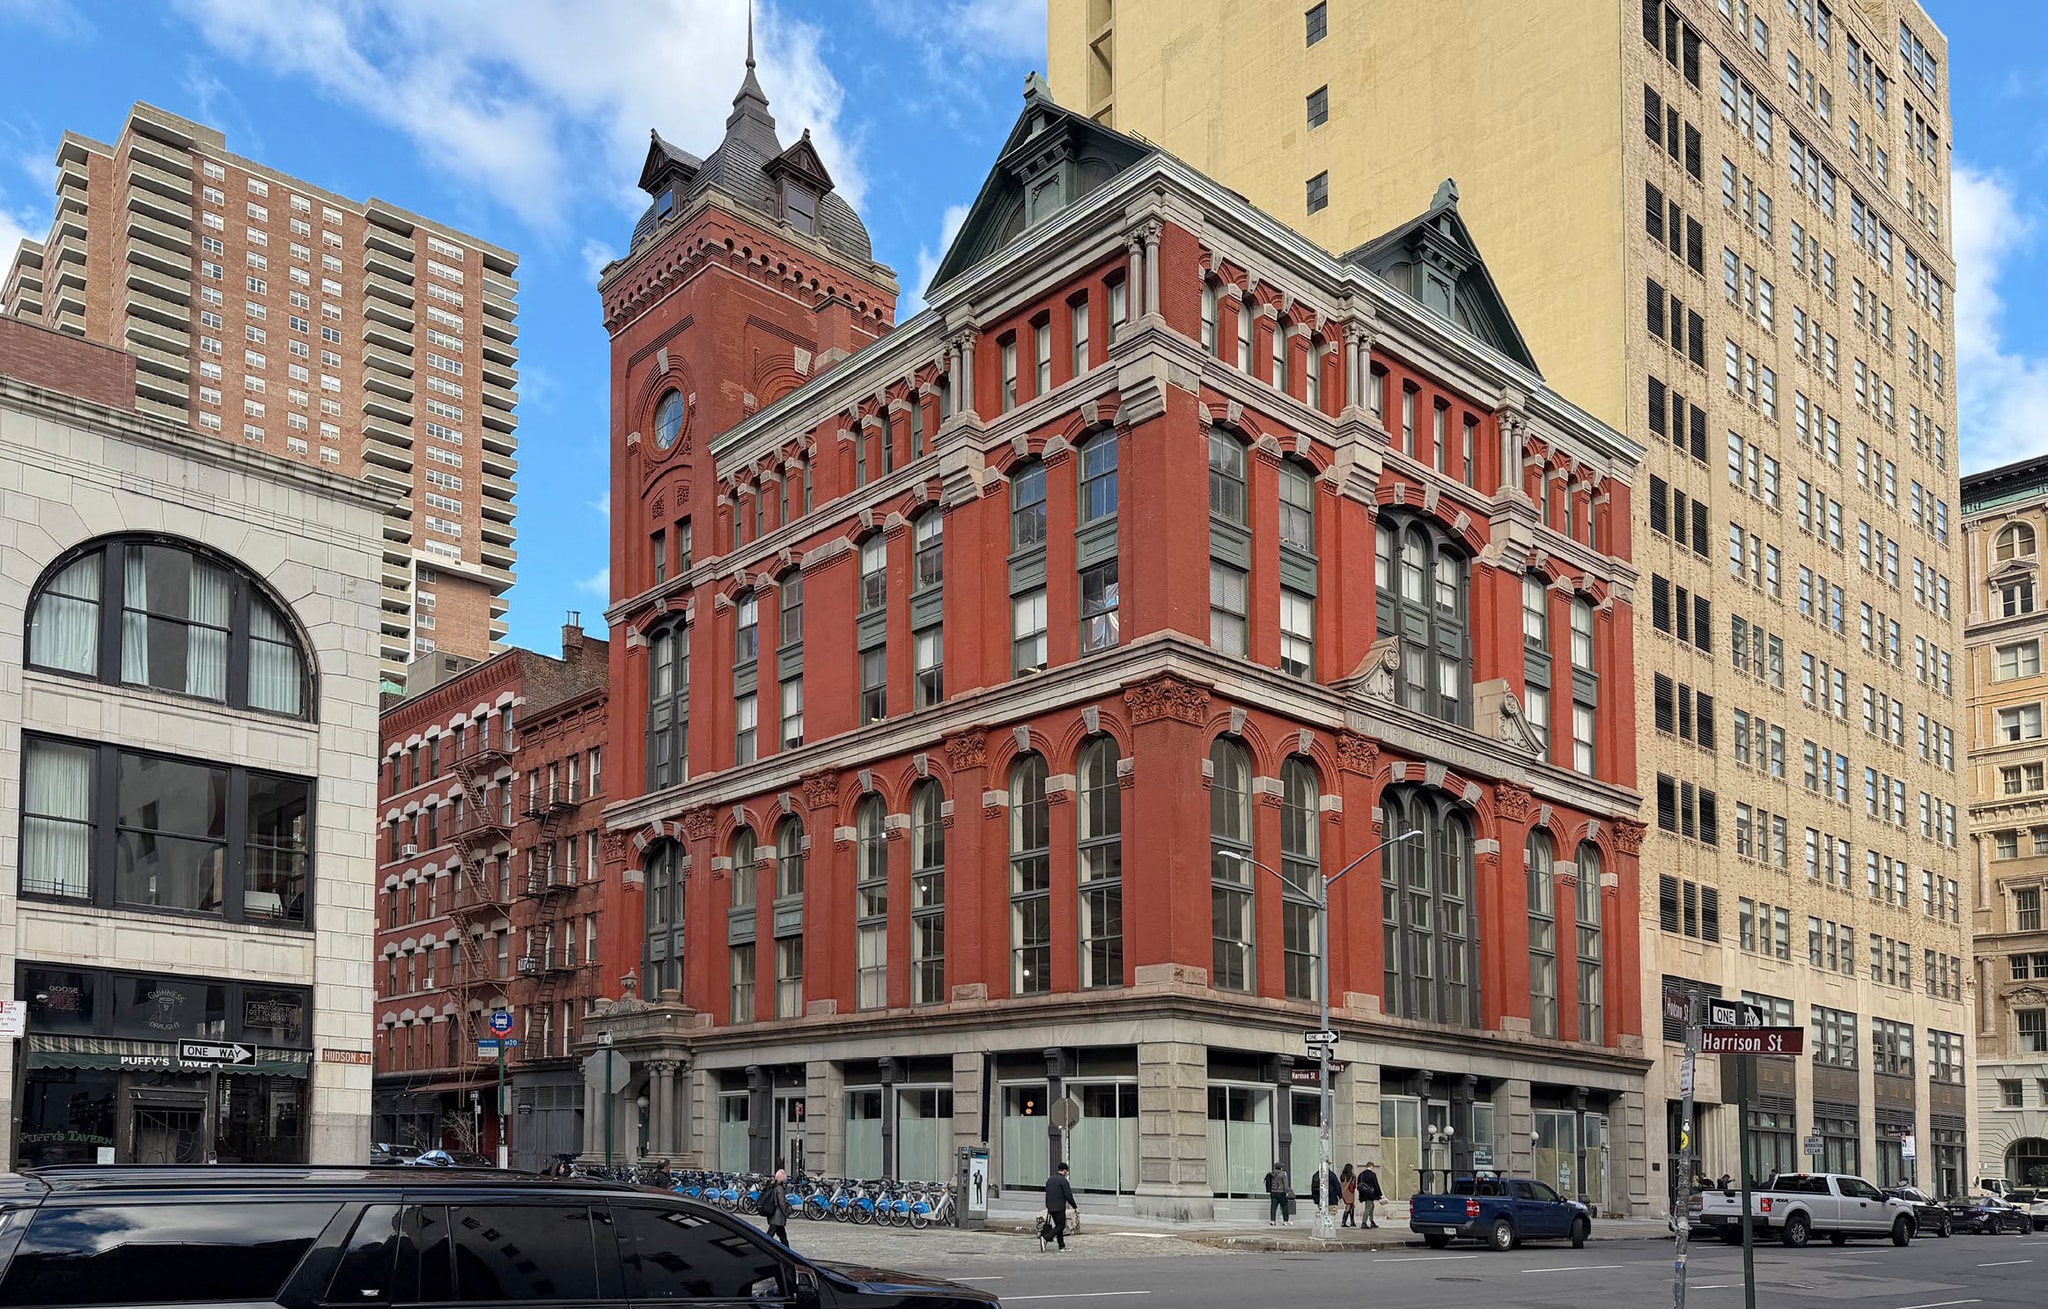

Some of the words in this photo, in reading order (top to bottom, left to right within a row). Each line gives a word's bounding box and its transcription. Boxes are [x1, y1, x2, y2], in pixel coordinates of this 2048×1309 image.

[1716, 1008, 1735, 1024] ONE
[1745, 1013, 1757, 1025] AY
[1702, 1033, 1761, 1051] Harrison
[1767, 1034, 1783, 1052] St
[187, 1046, 209, 1057] ONE
[219, 1048, 241, 1058] WAY
[324, 1050, 356, 1063] HUDSON
[359, 1053, 370, 1064] ST
[120, 1056, 170, 1066] PUFFY'S
[67, 1130, 113, 1145] TAVERN
